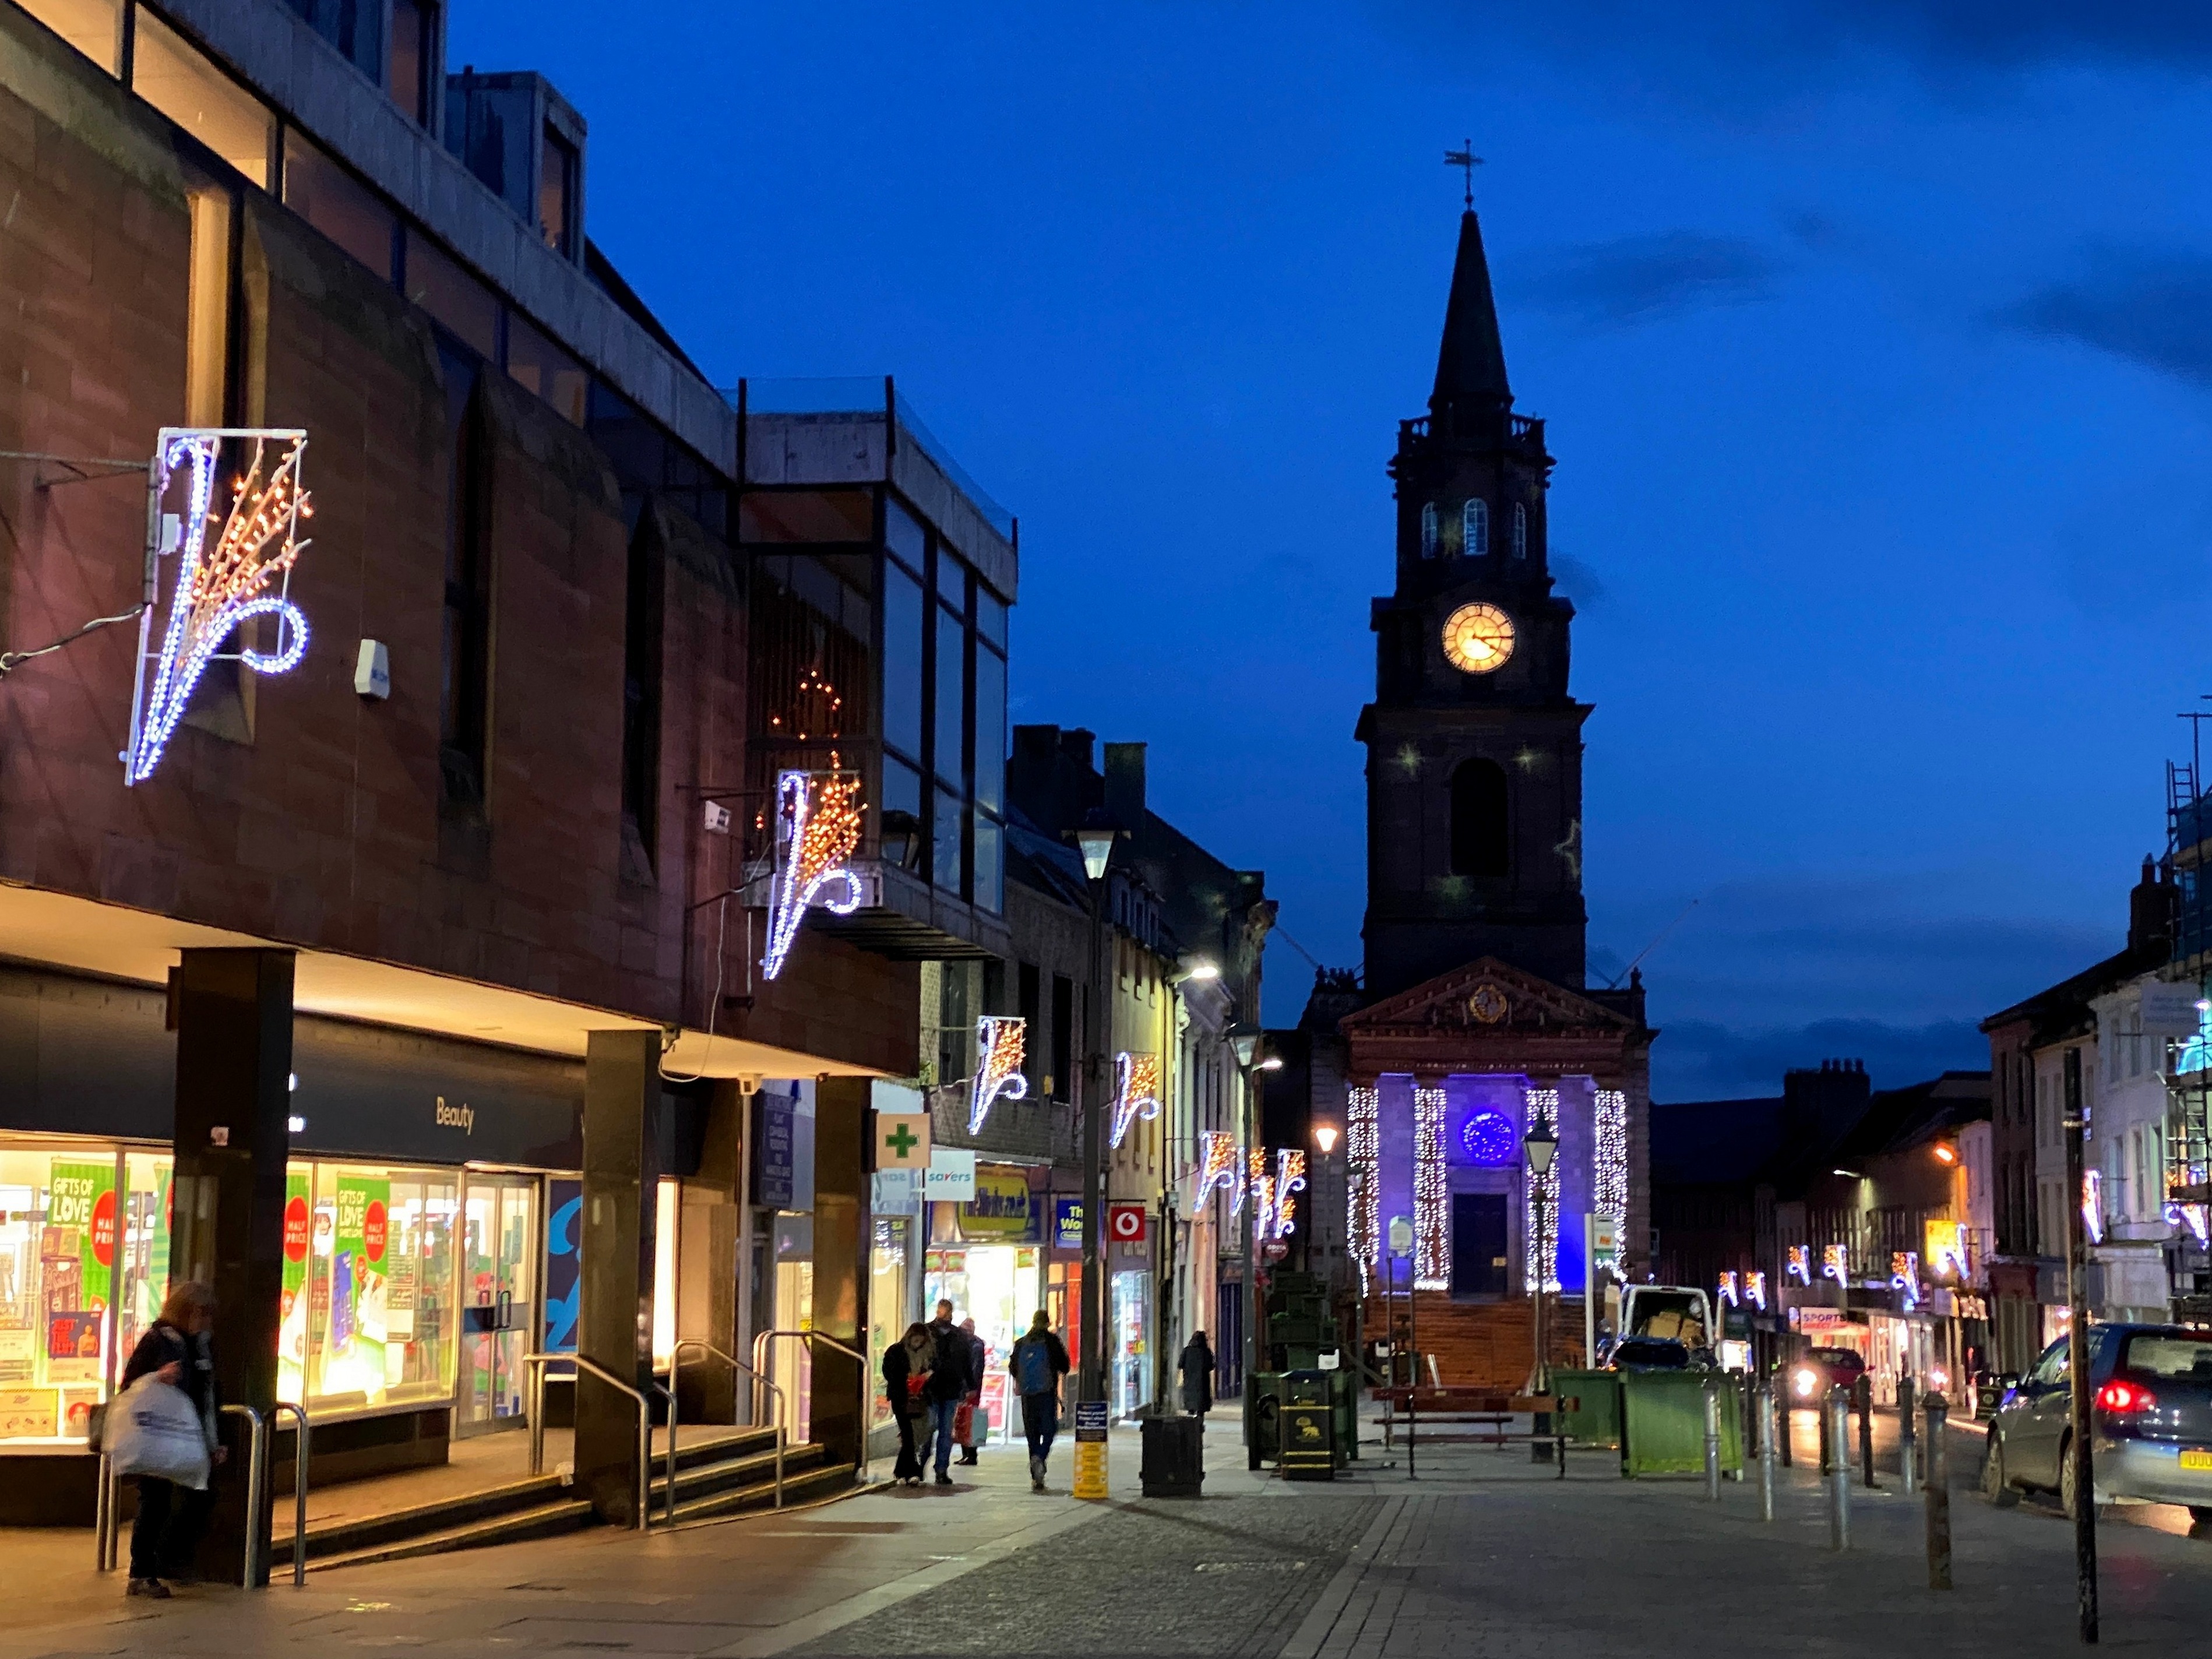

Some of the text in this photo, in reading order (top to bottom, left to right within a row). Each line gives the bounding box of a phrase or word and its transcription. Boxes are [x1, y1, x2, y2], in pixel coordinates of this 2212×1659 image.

[436, 1096, 474, 1135] Beauty
[928, 1171, 971, 1182] savers
[54, 1177, 94, 1196] GIFTS OF
[339, 1190, 366, 1204] GIFTS OF
[53, 1196, 90, 1223] LOVE
[1069, 1206, 1083, 1218] Th
[339, 1206, 364, 1227] LOVE
[288, 1221, 305, 1231] HALF
[368, 1223, 383, 1233] HALF
[286, 1232, 307, 1244] PRICE
[366, 1234, 383, 1245] PRICE
